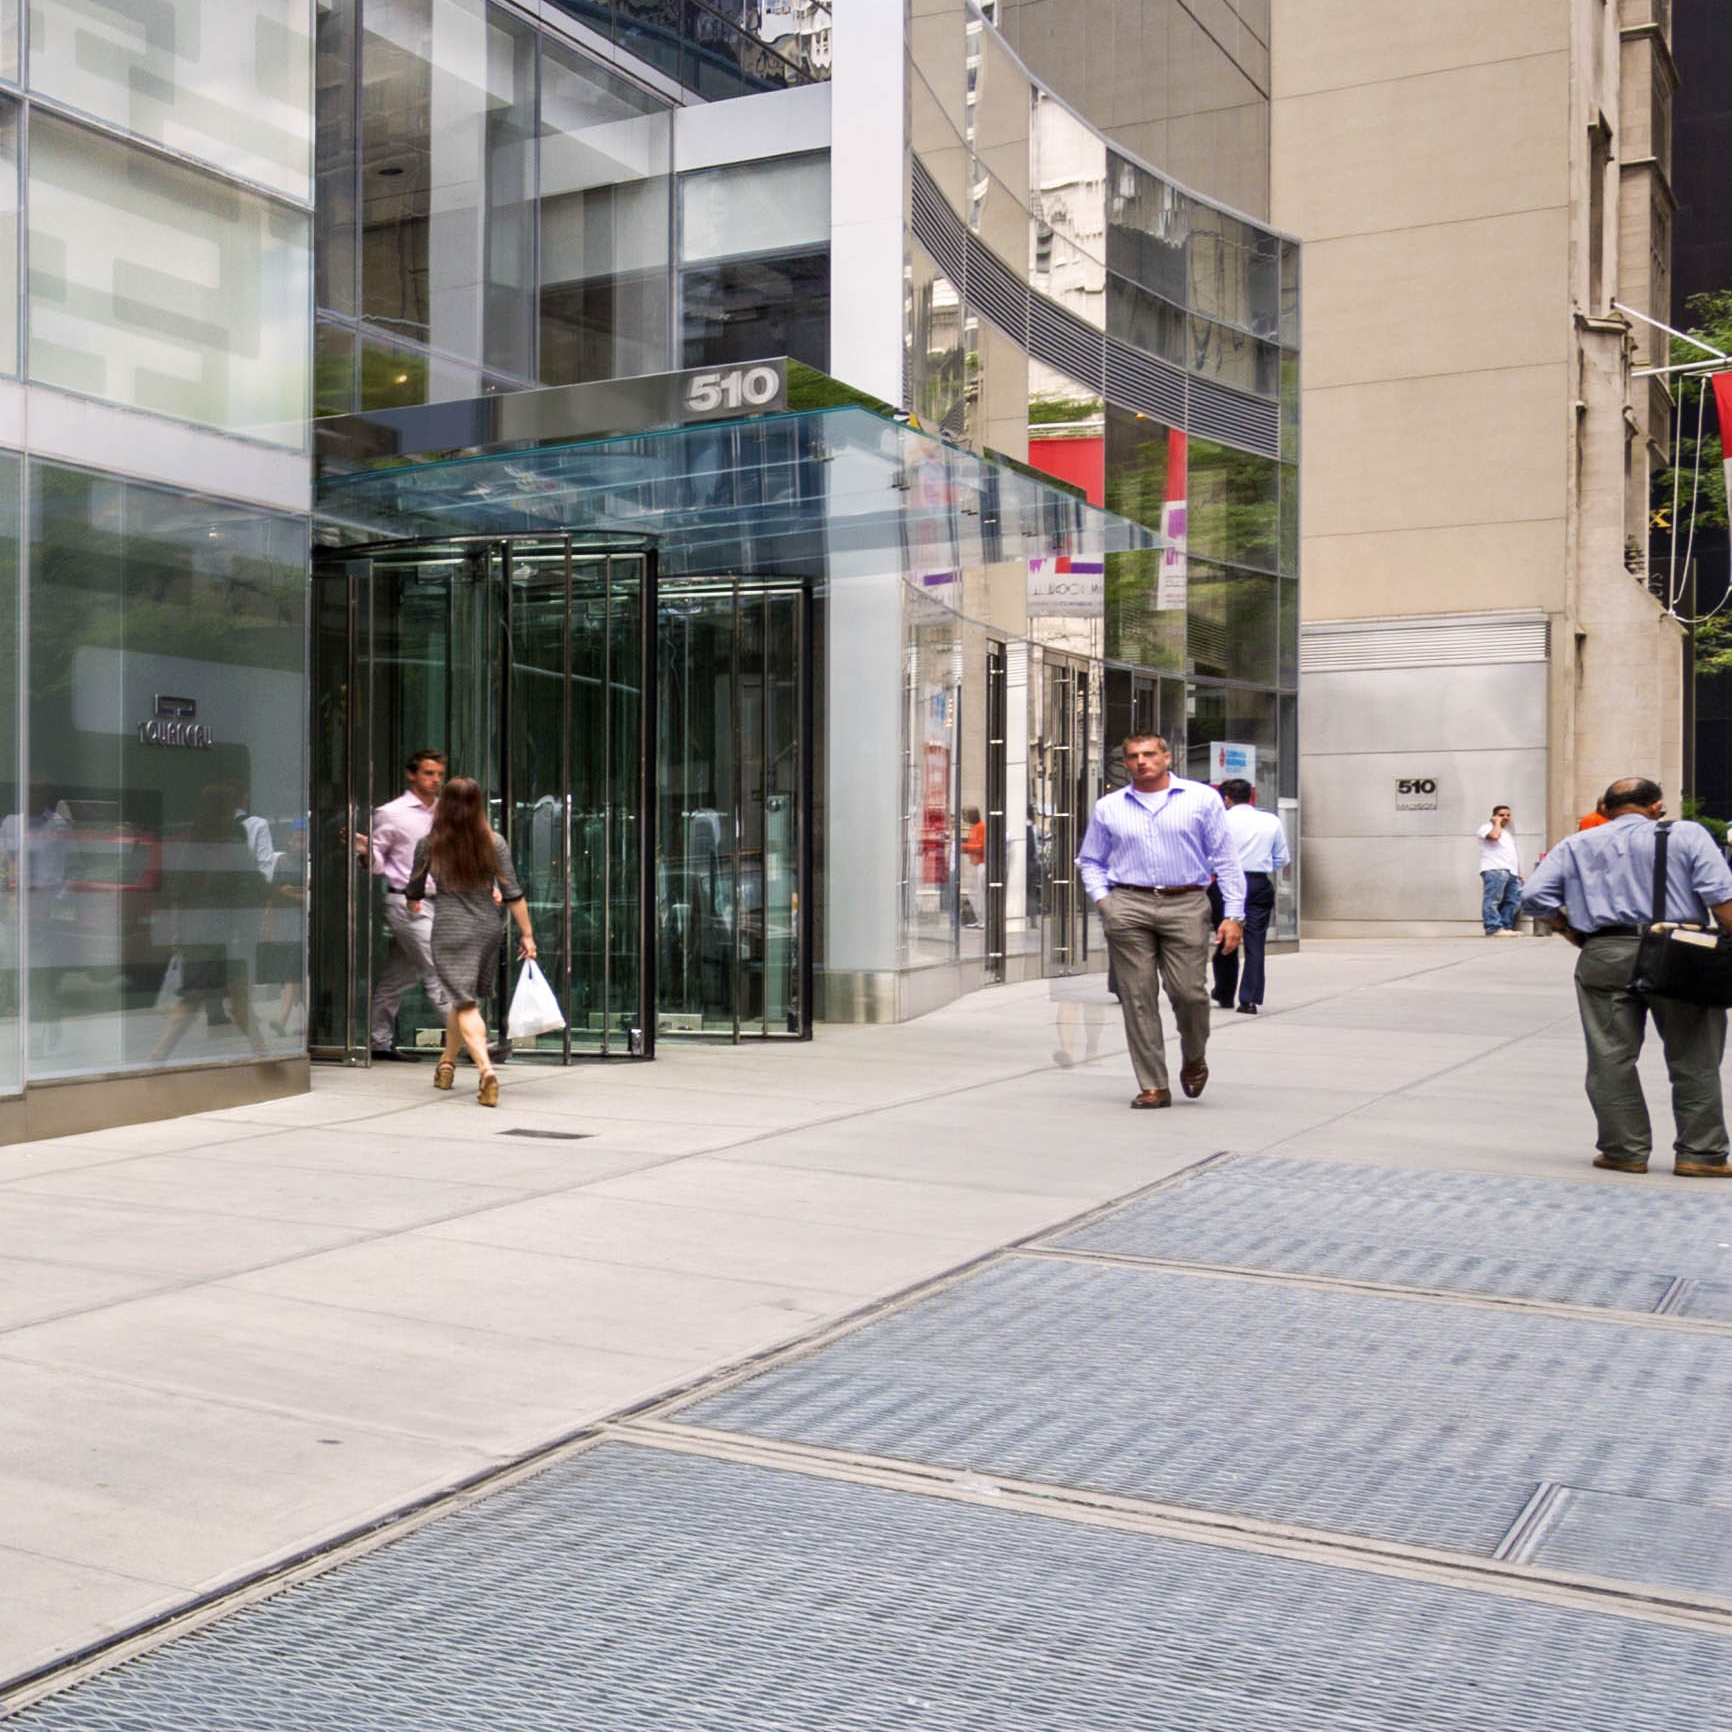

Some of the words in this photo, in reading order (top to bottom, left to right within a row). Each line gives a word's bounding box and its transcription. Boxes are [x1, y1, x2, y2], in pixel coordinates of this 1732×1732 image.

[686, 366, 779, 412] 510
[137, 720, 213, 748] TOURNEAU
[1398, 779, 1436, 794] 510
